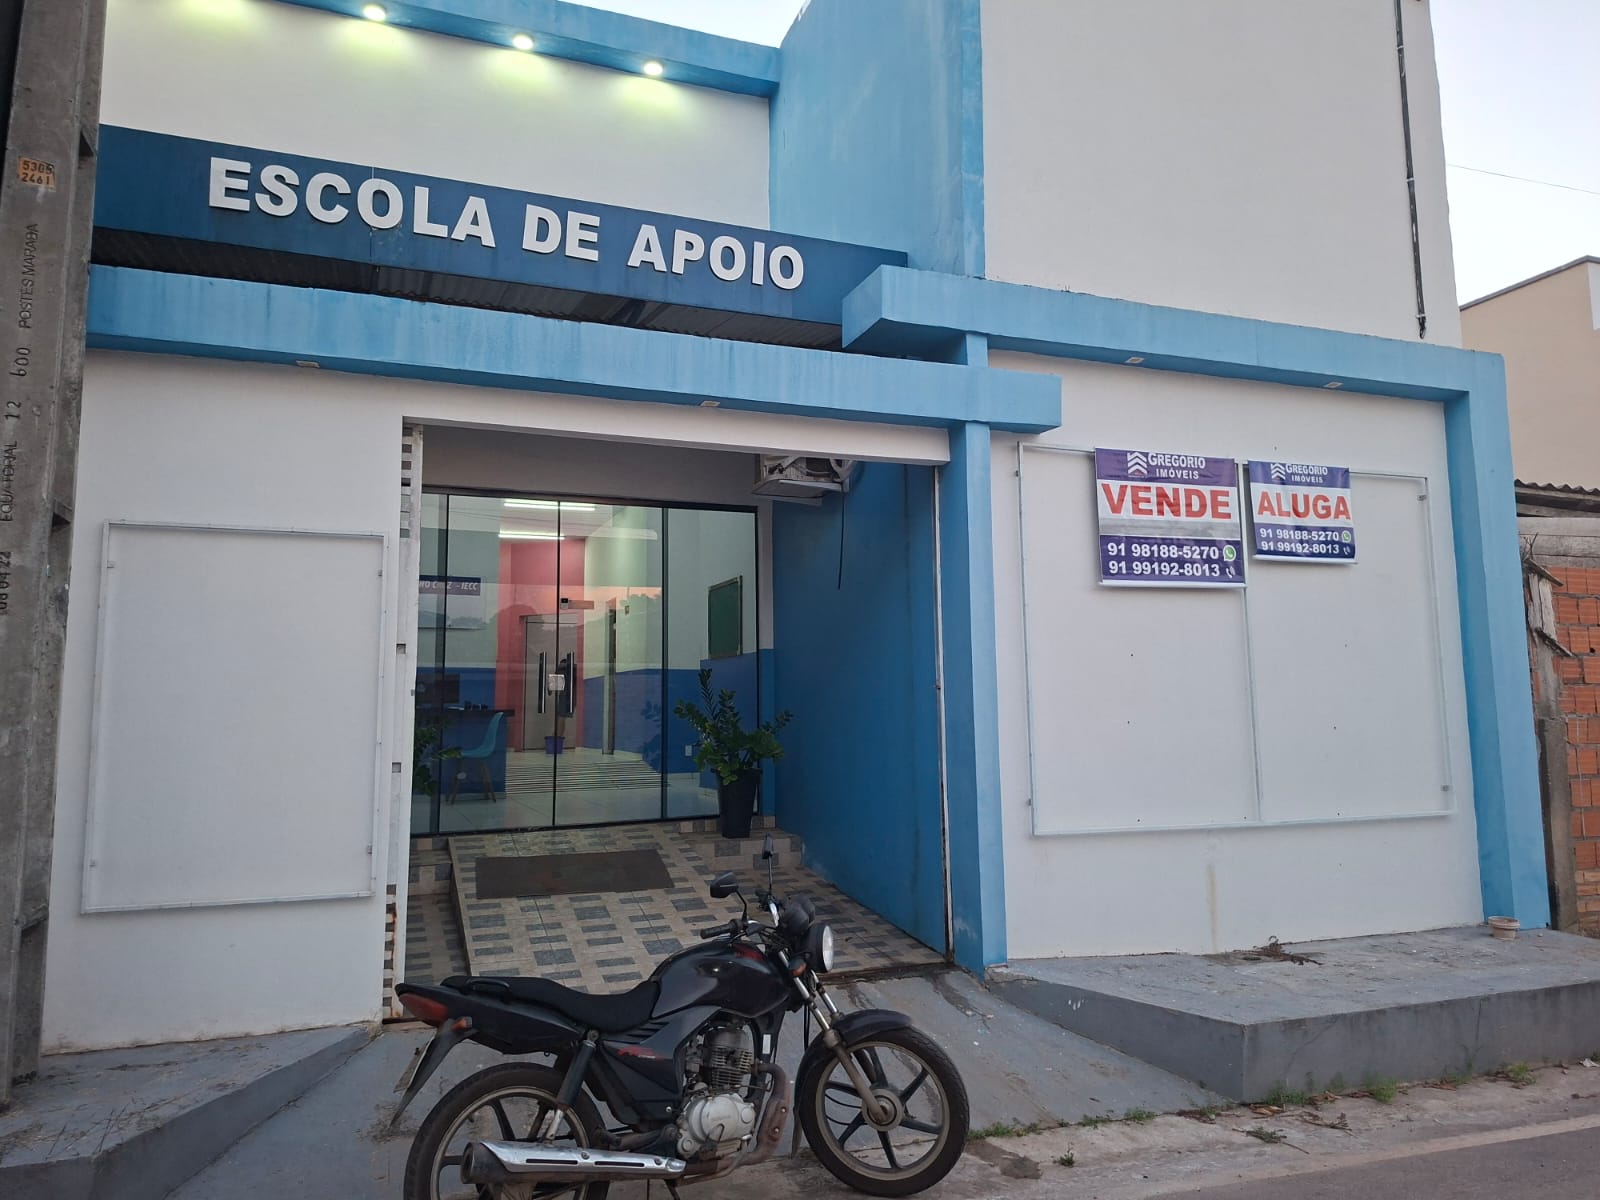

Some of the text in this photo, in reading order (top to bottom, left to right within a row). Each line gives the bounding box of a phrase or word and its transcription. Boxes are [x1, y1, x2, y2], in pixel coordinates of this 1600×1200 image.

[21, 172, 50, 185] 2461
[208, 157, 804, 290] ESCOLA DE APOIO
[18, 279, 34, 329] POSTES
[9, 347, 31, 377] 600
[4, 401, 22, 420] 12
[1147, 453, 1206, 469] GREGORIO
[1285, 463, 1329, 476] GREGORIO
[1156, 467, 1200, 480] IMÓVEIS
[1101, 483, 1232, 520] VENDE
[1257, 491, 1351, 521] ALUGA
[1260, 528, 1340, 541] 91 98188-5270
[1107, 542, 1219, 560] 91 98188-5270
[1261, 541, 1340, 554] 91 99192-8013
[1108, 560, 1220, 577] 91 99192-8013
[432, 581, 452, 590] CZ
